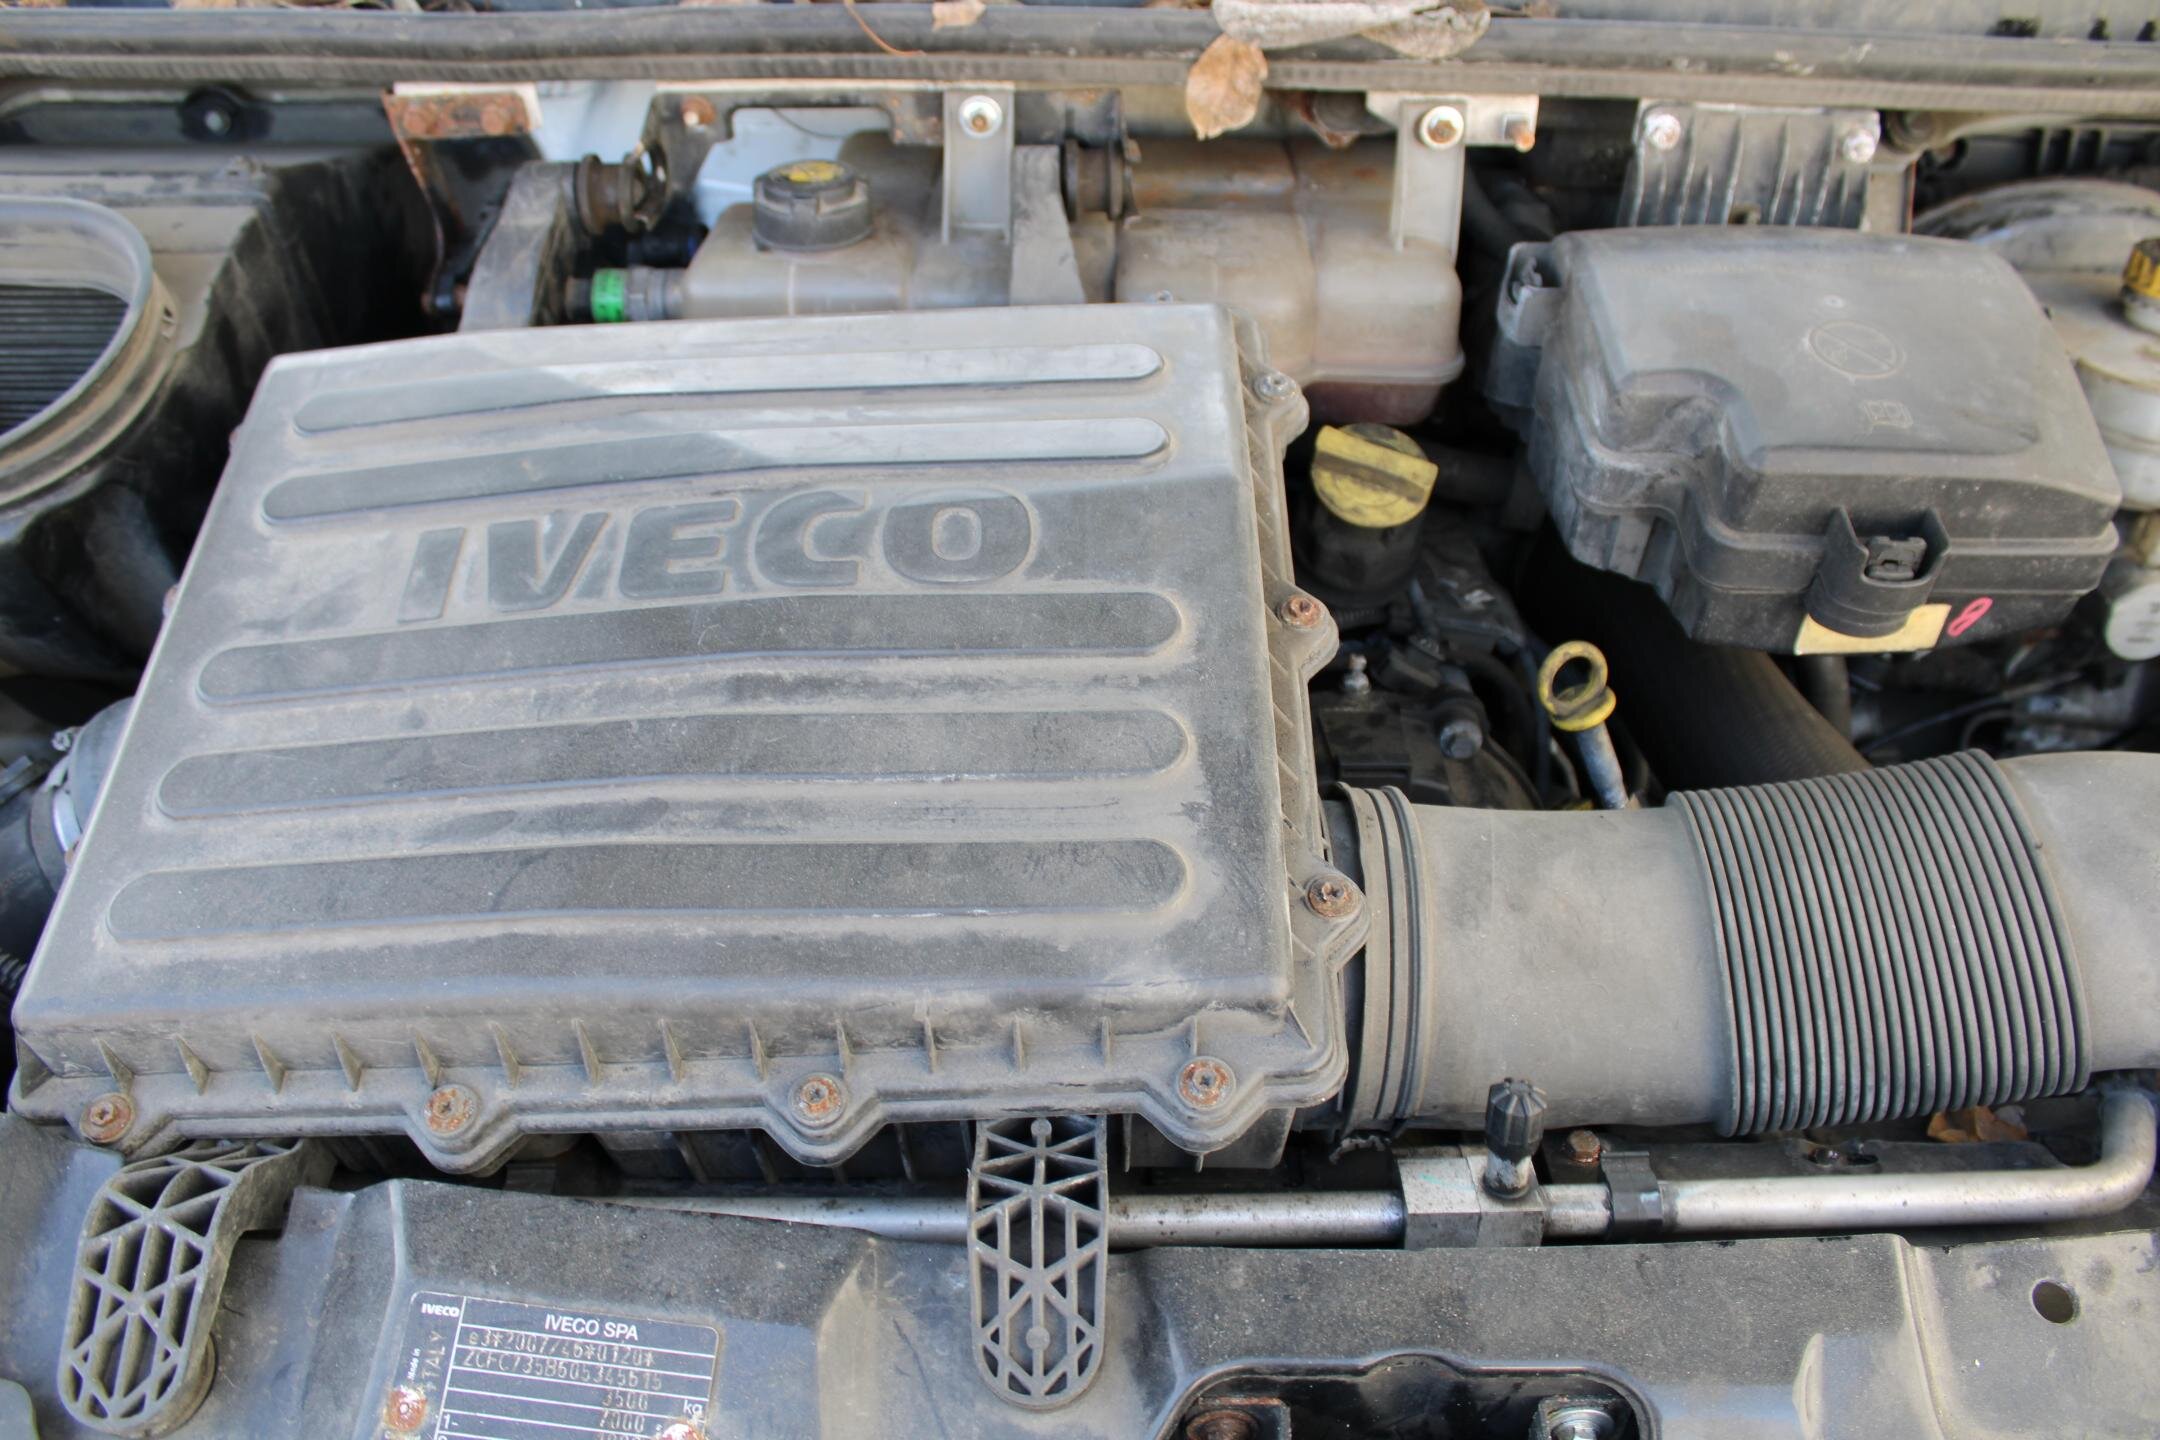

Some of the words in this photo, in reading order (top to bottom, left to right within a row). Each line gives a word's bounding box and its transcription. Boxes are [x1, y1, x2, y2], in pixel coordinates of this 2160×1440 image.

[398, 489, 1033, 621] IVECO
[422, 1303, 461, 1317] IVECO
[545, 1313, 600, 1336] IVECO
[603, 1322, 639, 1341] SPA
